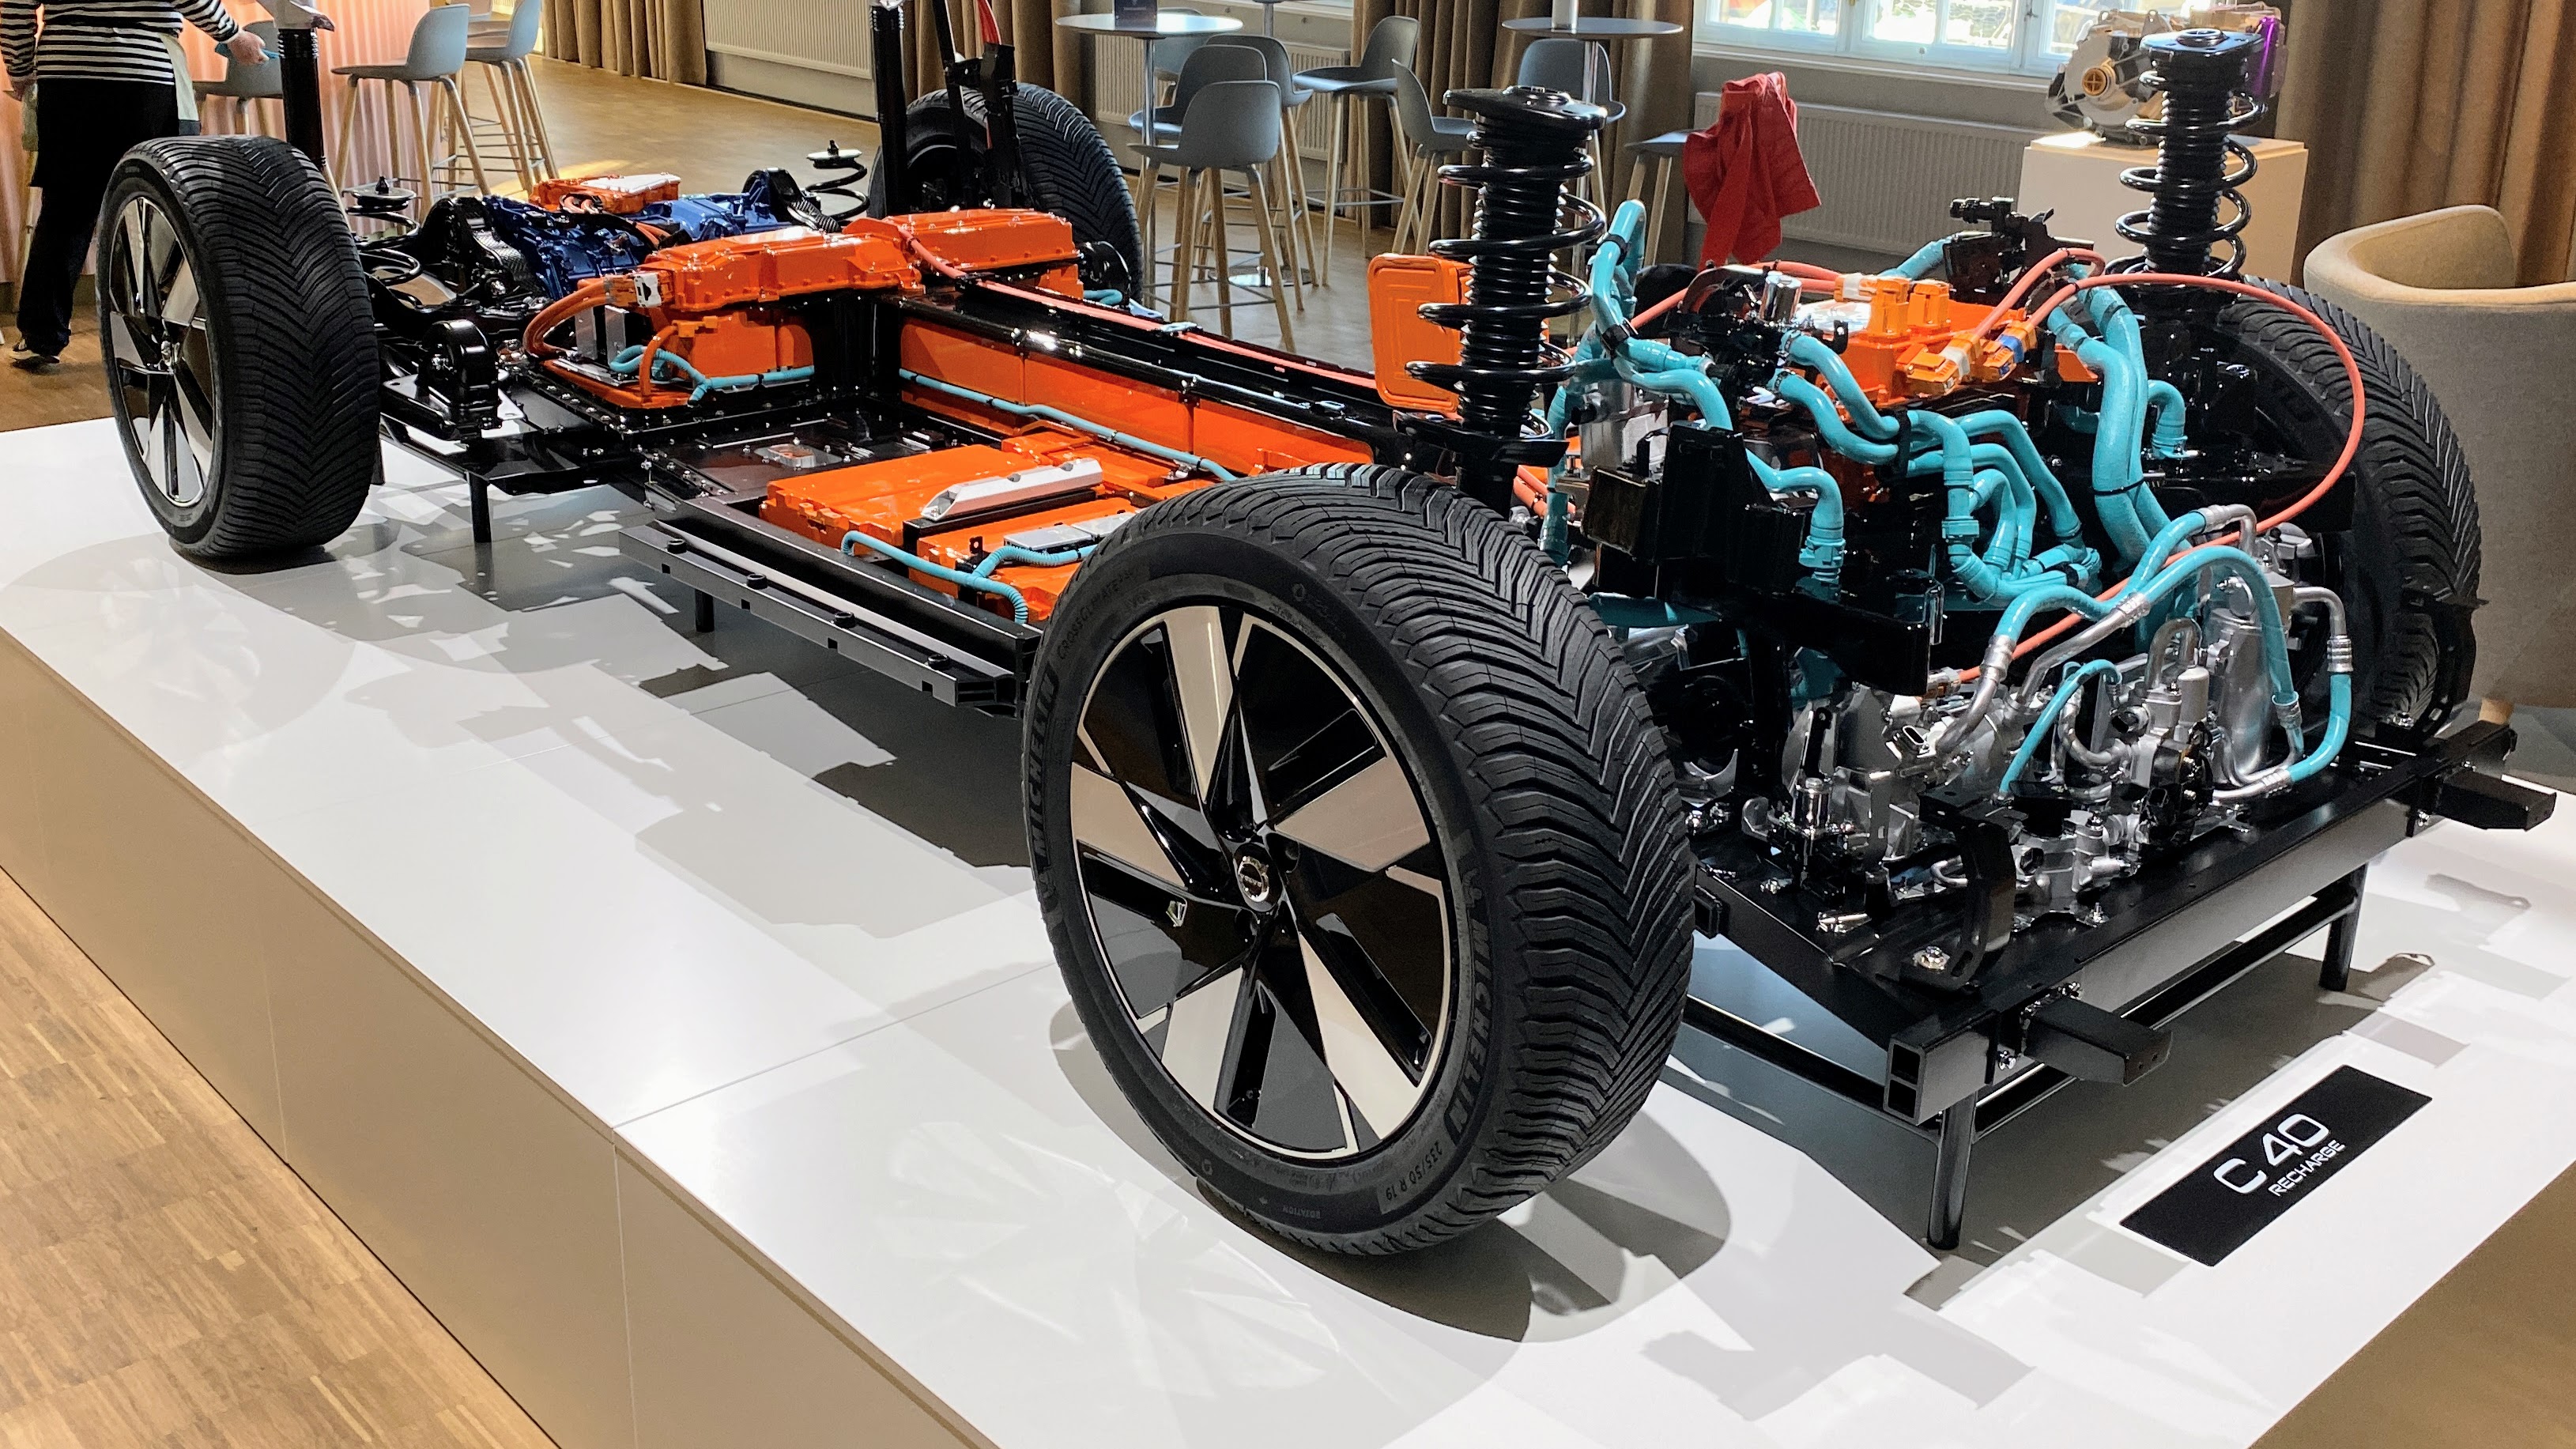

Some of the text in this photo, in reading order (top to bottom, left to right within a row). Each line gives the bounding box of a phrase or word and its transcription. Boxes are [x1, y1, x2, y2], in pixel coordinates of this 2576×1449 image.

[1029, 673, 1054, 858] MICHELIN
[1449, 918, 1493, 1132] MICHELIN
[1397, 1179, 1408, 1193] R
[1407, 1141, 1444, 1187] 235/50
[2267, 1139, 2346, 1197] RECHARGE
